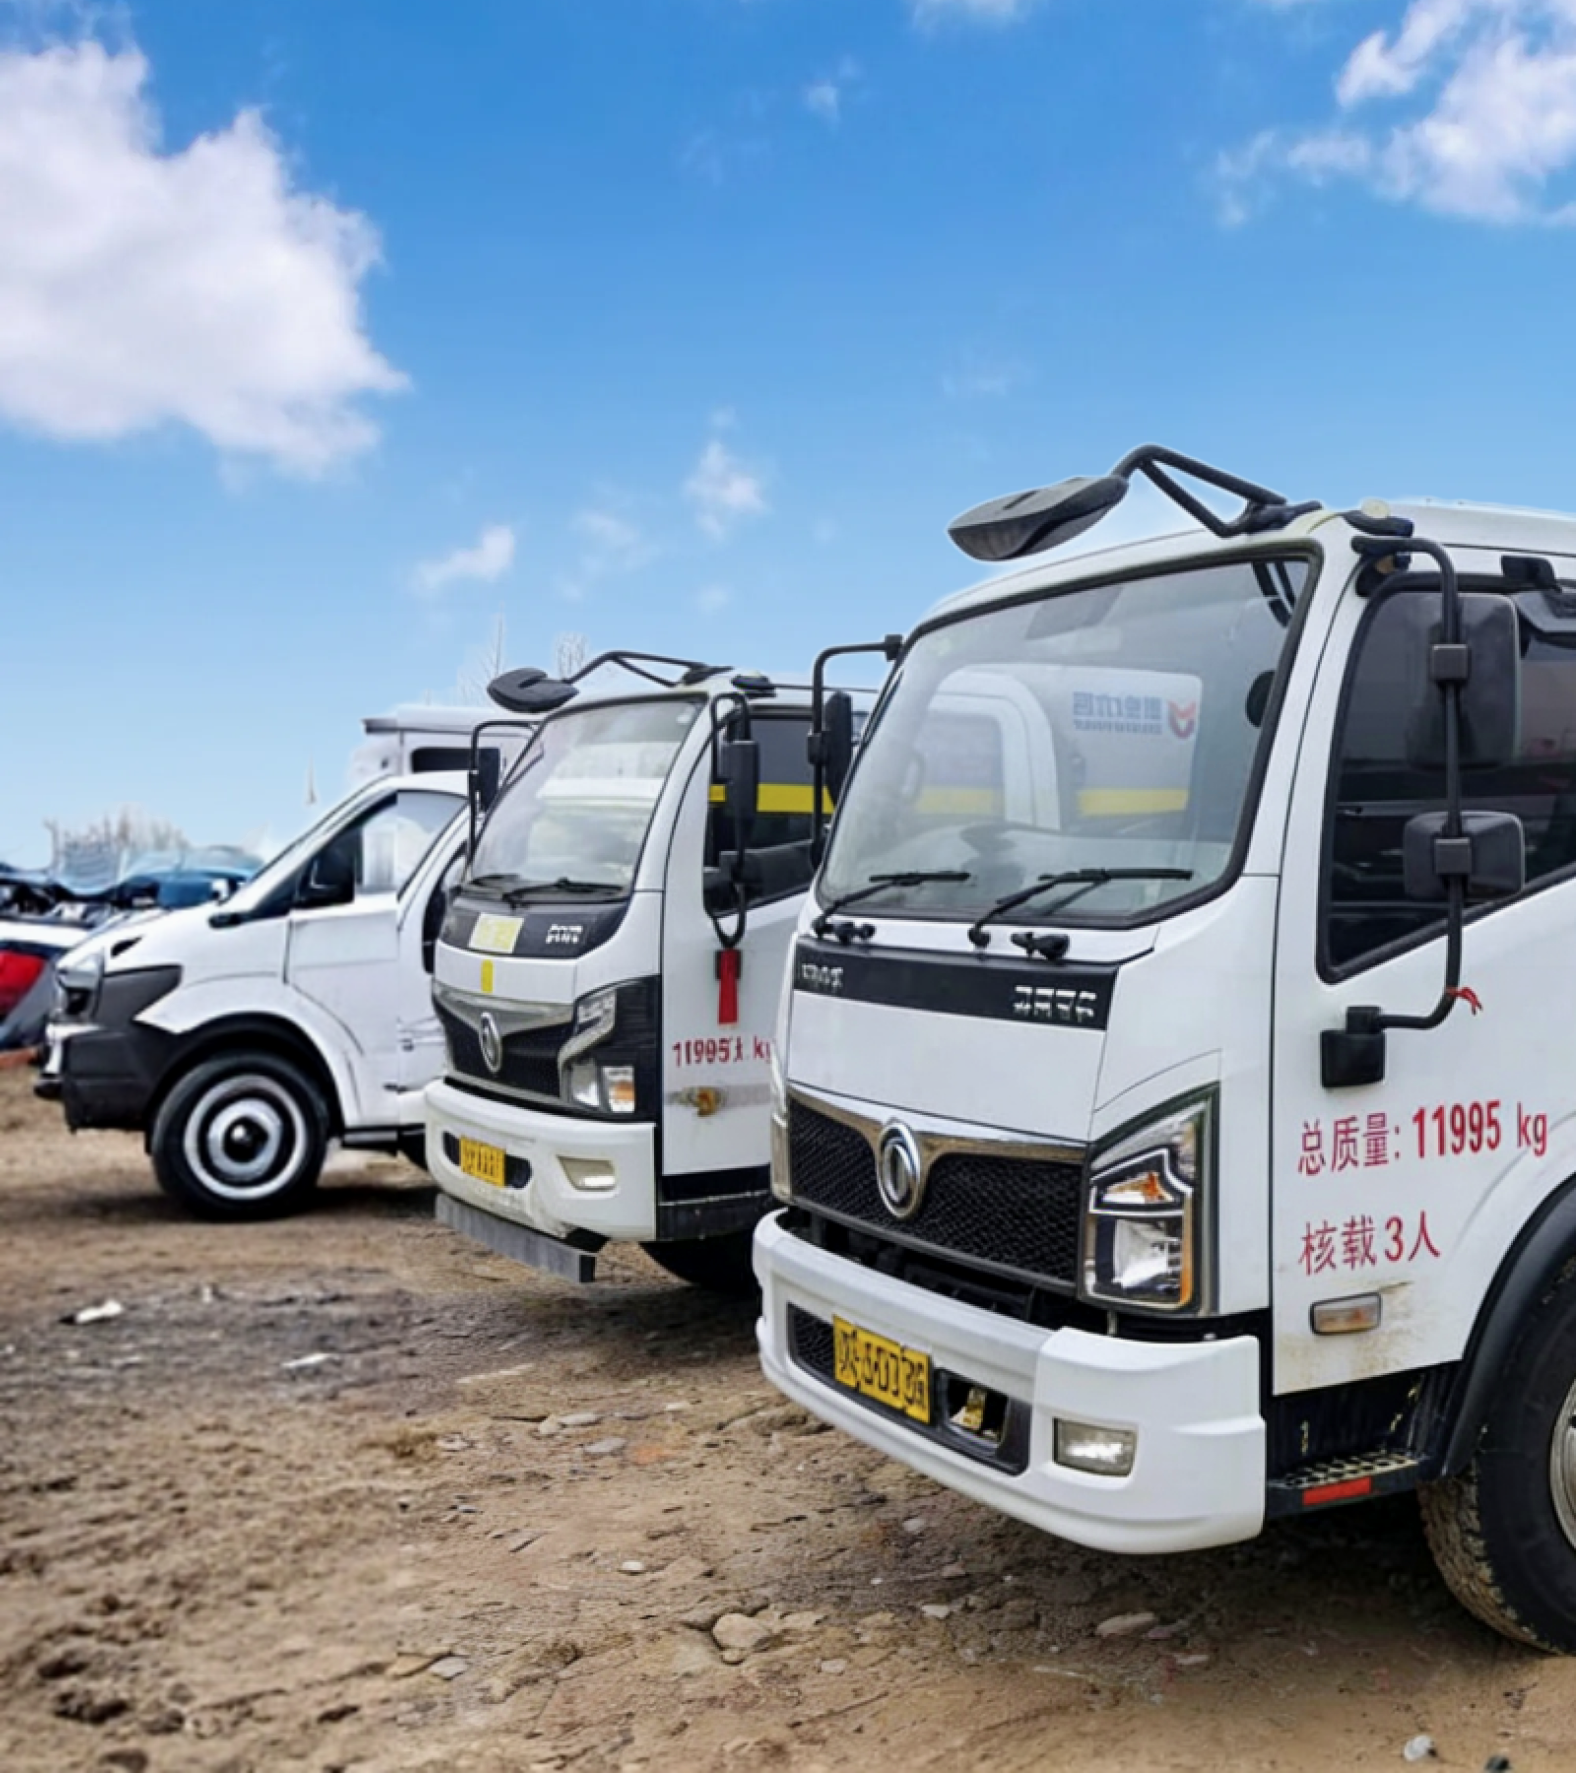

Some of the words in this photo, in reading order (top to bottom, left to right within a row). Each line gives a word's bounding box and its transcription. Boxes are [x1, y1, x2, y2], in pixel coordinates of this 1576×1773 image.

[1411, 1099, 1502, 1159] 11995
[1516, 1101, 1549, 1158] kg
[1298, 1210, 1441, 1276] 核载3人
